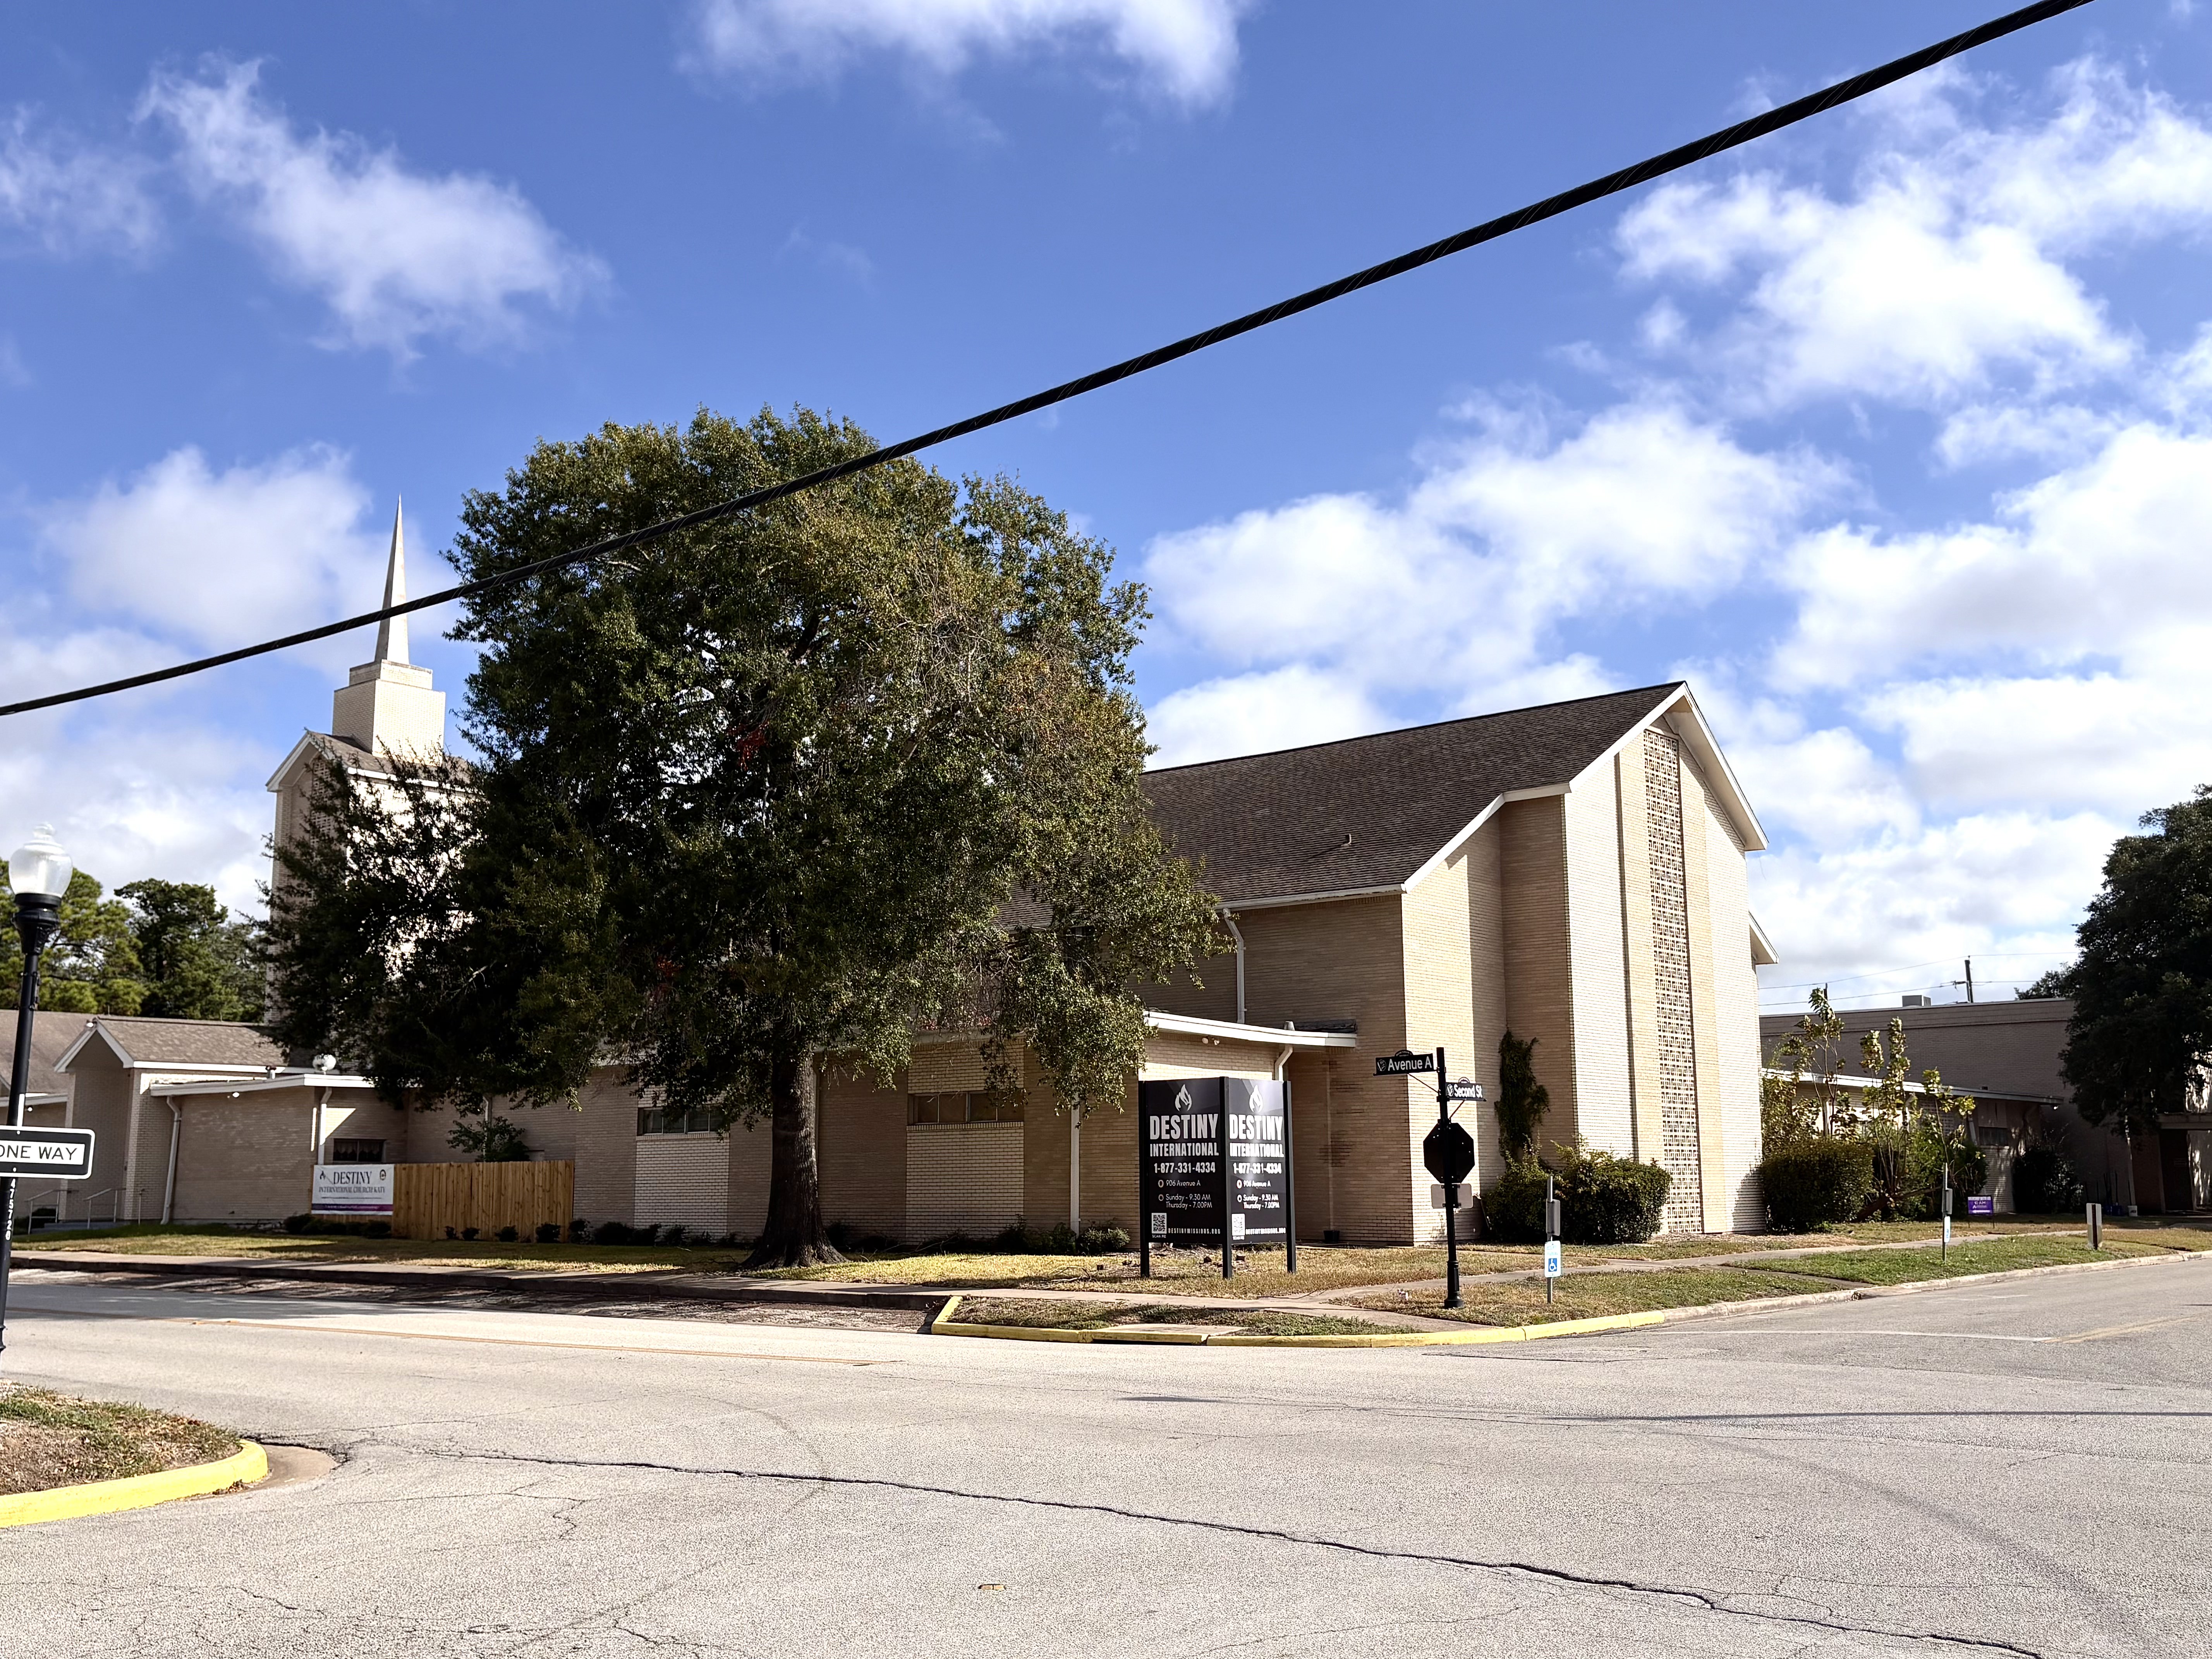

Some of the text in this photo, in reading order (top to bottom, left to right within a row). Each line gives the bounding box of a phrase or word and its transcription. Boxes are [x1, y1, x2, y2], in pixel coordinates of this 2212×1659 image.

[1388, 1056, 1432, 1071] Avenue A
[1454, 1084, 1483, 1098] Second St
[1150, 1113, 1219, 1140] DESTINY
[1229, 1114, 1283, 1140] DESTINY
[39, 1146, 77, 1161] WAY
[1150, 1142, 1219, 1157] INTERNATIONAL
[1230, 1142, 1285, 1158] INTERNATIONAL
[1154, 1162, 1216, 1173] 1-877-331-4334
[333, 1171, 372, 1185] DESTINY
[1166, 1194, 1185, 1202] Sunday
[1166, 1201, 1188, 1210] Thursday
